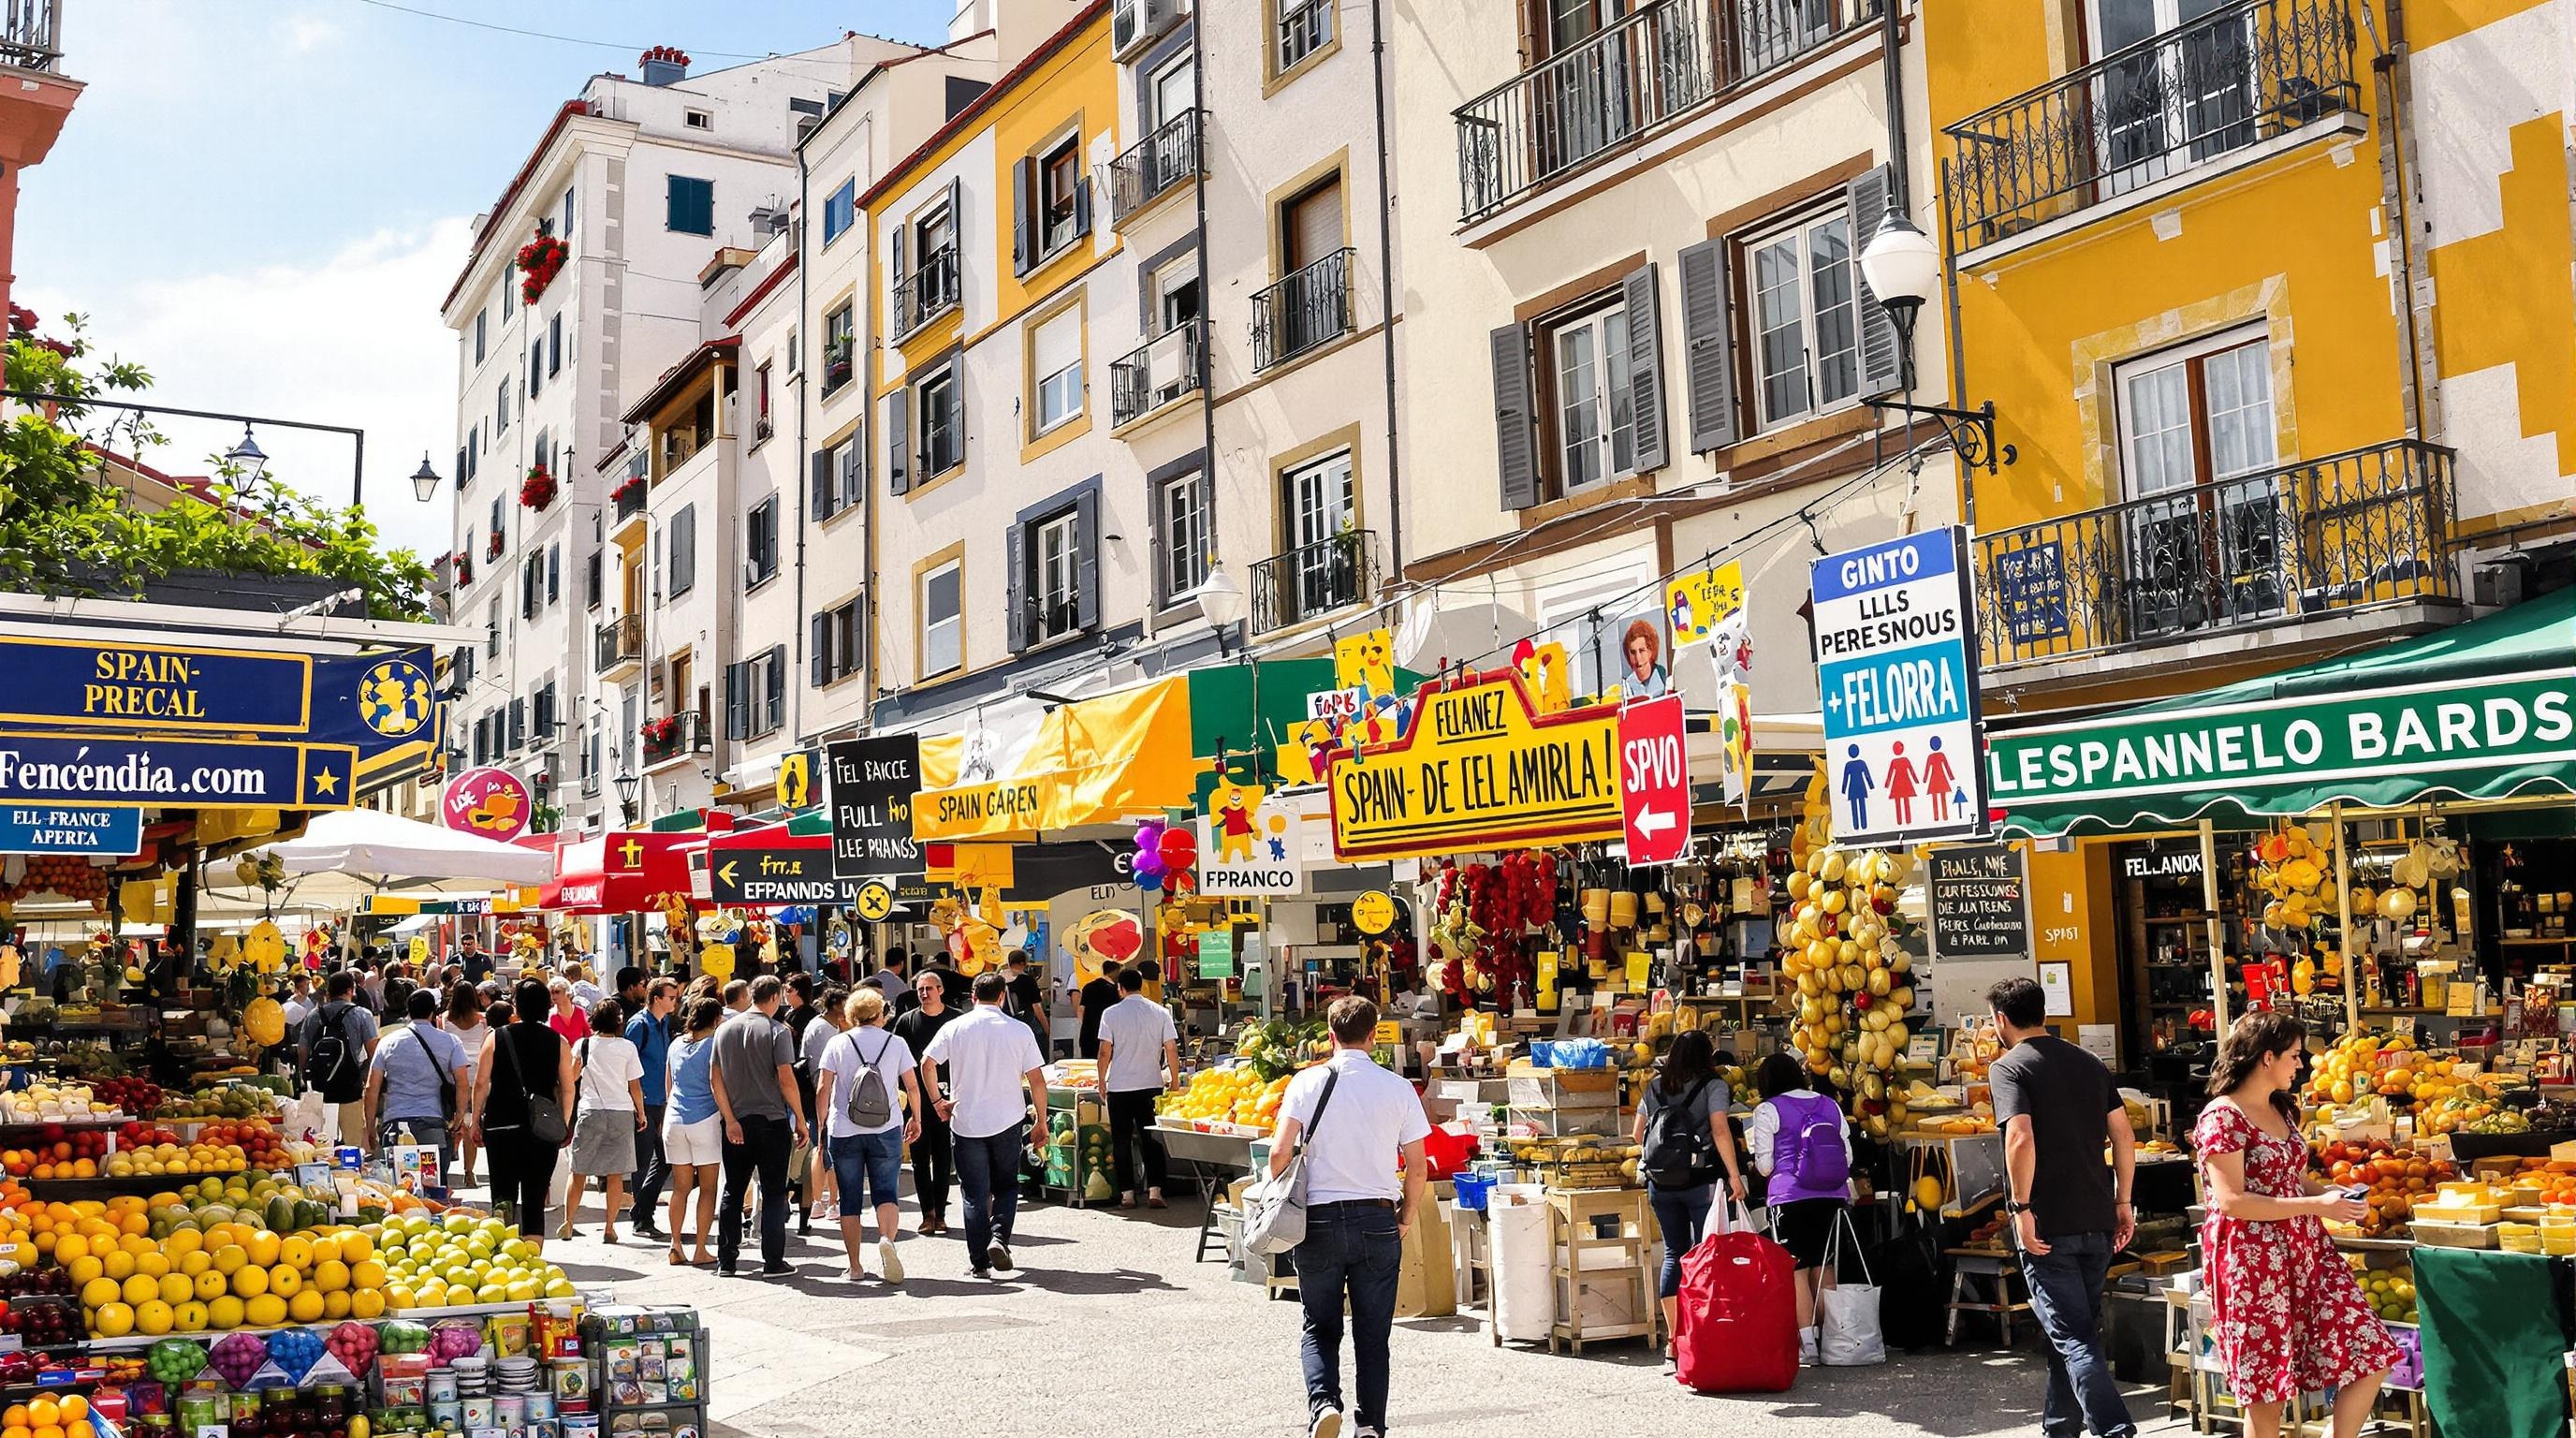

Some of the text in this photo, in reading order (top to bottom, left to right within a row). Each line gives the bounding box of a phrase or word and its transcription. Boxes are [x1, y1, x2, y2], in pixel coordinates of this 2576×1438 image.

[1841, 545, 1920, 590] GINTO
[1859, 590, 1910, 621] LLLS
[95, 651, 200, 684] SPAIN-
[83, 684, 206, 718] PRECAL
[1990, 691, 2573, 792] LESPANNELO BARDS
[1624, 733, 1681, 794] SPVO
[939, 785, 1038, 823] SPAIN GAREN
[1422, 760, 1456, 815] DE
[839, 838, 864, 858] LEE
[744, 880, 835, 900] EFPANNDS
[1206, 870, 1294, 888] FPRANCO
